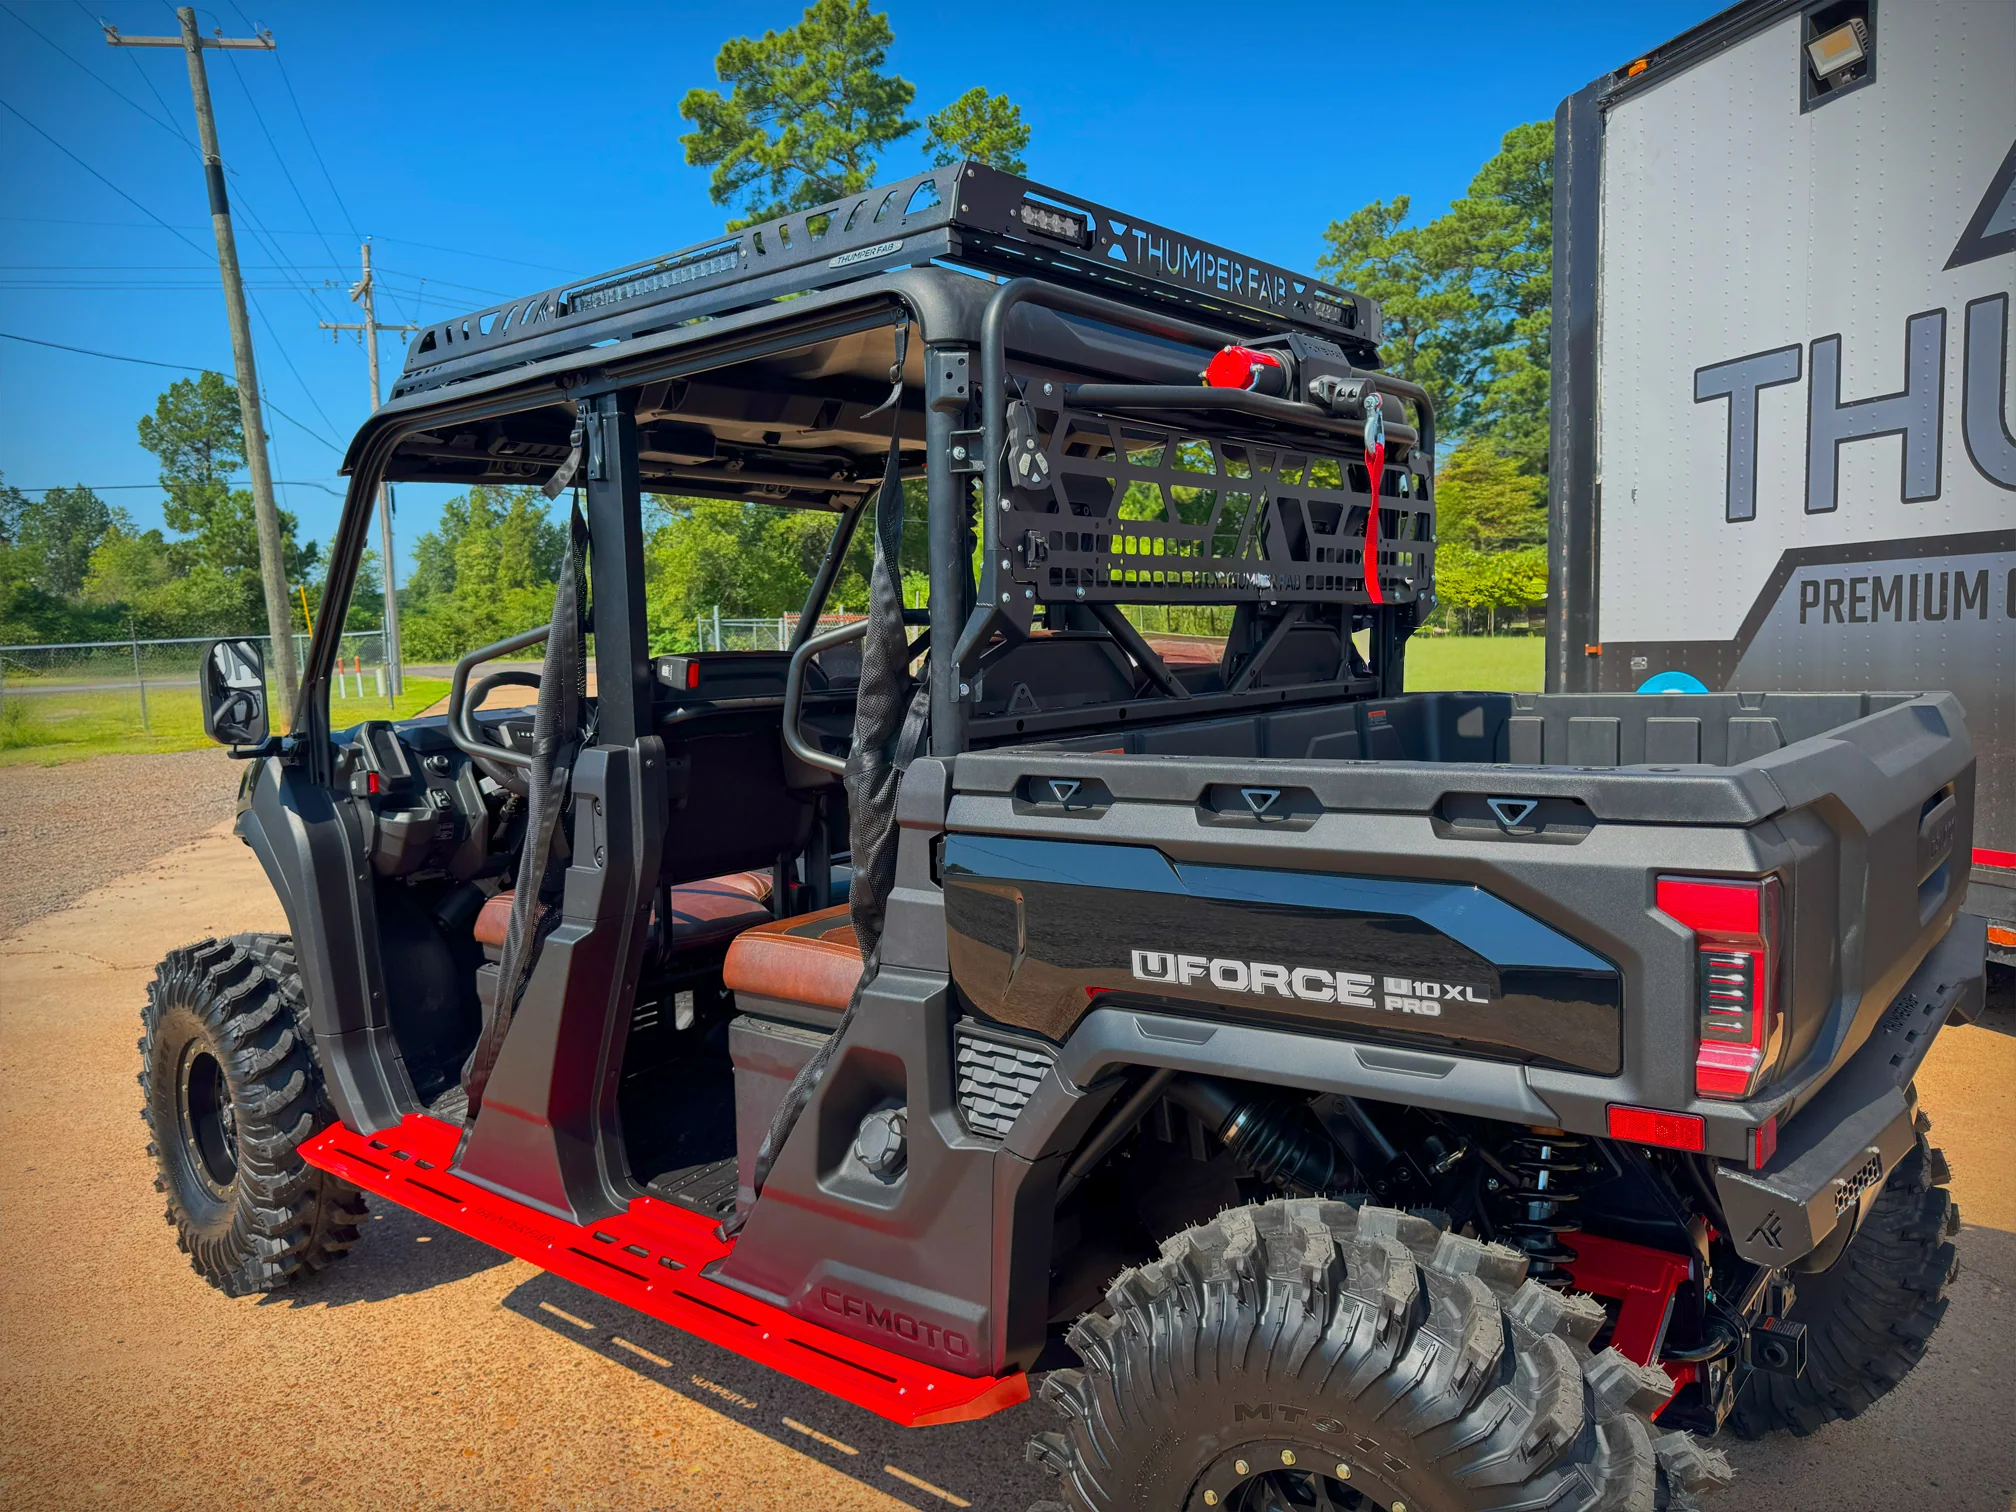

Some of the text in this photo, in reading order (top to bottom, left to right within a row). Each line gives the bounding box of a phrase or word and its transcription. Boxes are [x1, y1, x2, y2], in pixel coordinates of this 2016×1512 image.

[837, 242, 894, 265] THUMPER FAB
[1131, 228, 1287, 306] THUMPER FAB
[1799, 568, 1990, 625] PREMIUM
[1384, 995, 1442, 1017] PRO
[1442, 983, 1489, 1004] XL
[821, 1286, 970, 1360] CFMOTO
